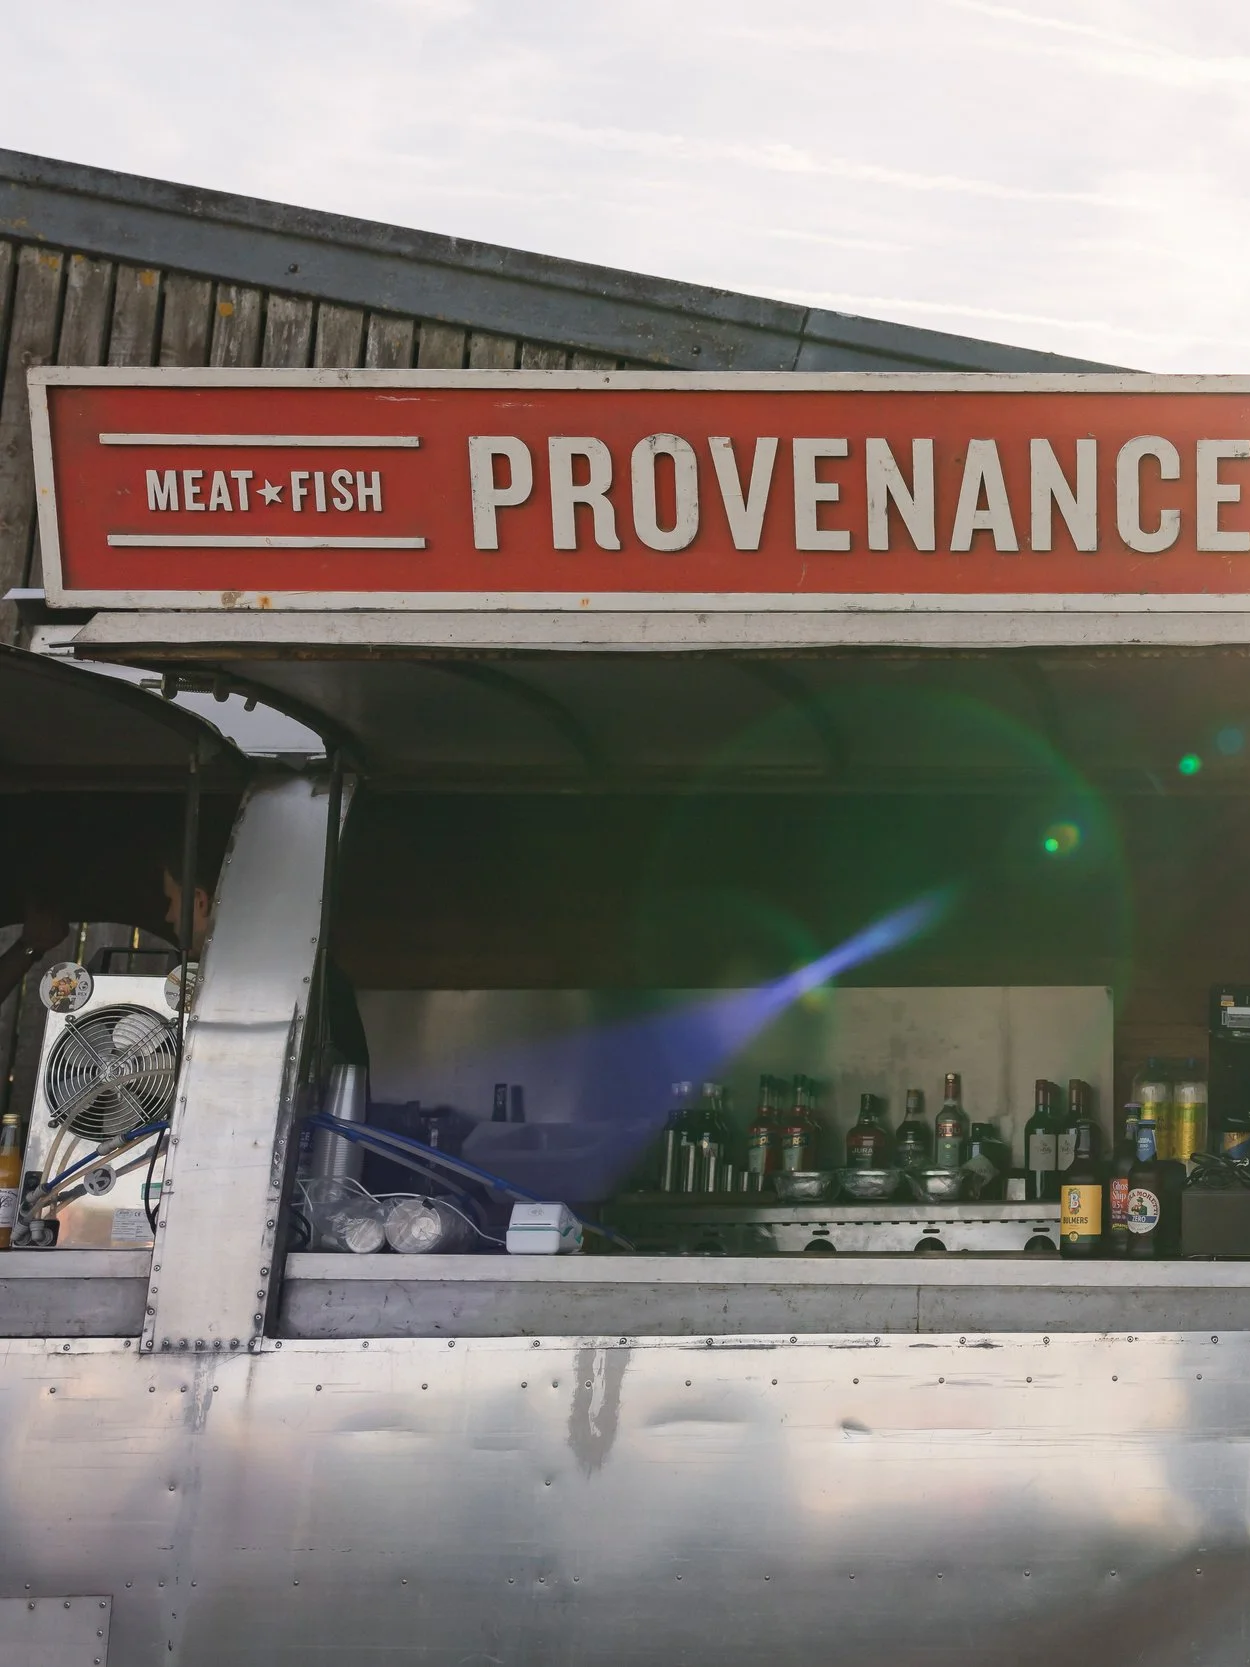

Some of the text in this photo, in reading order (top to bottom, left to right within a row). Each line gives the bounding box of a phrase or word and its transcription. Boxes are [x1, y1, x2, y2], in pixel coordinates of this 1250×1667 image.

[146, 469, 384, 513] MEAT FISH
[1112, 1180, 1129, 1191] Ghos
[1112, 1190, 1127, 1203] Ship
[1136, 1190, 1158, 1216] MORETTI
[1063, 1216, 1089, 1225] BULMERS
[1132, 1215, 1146, 1223] ZERO
